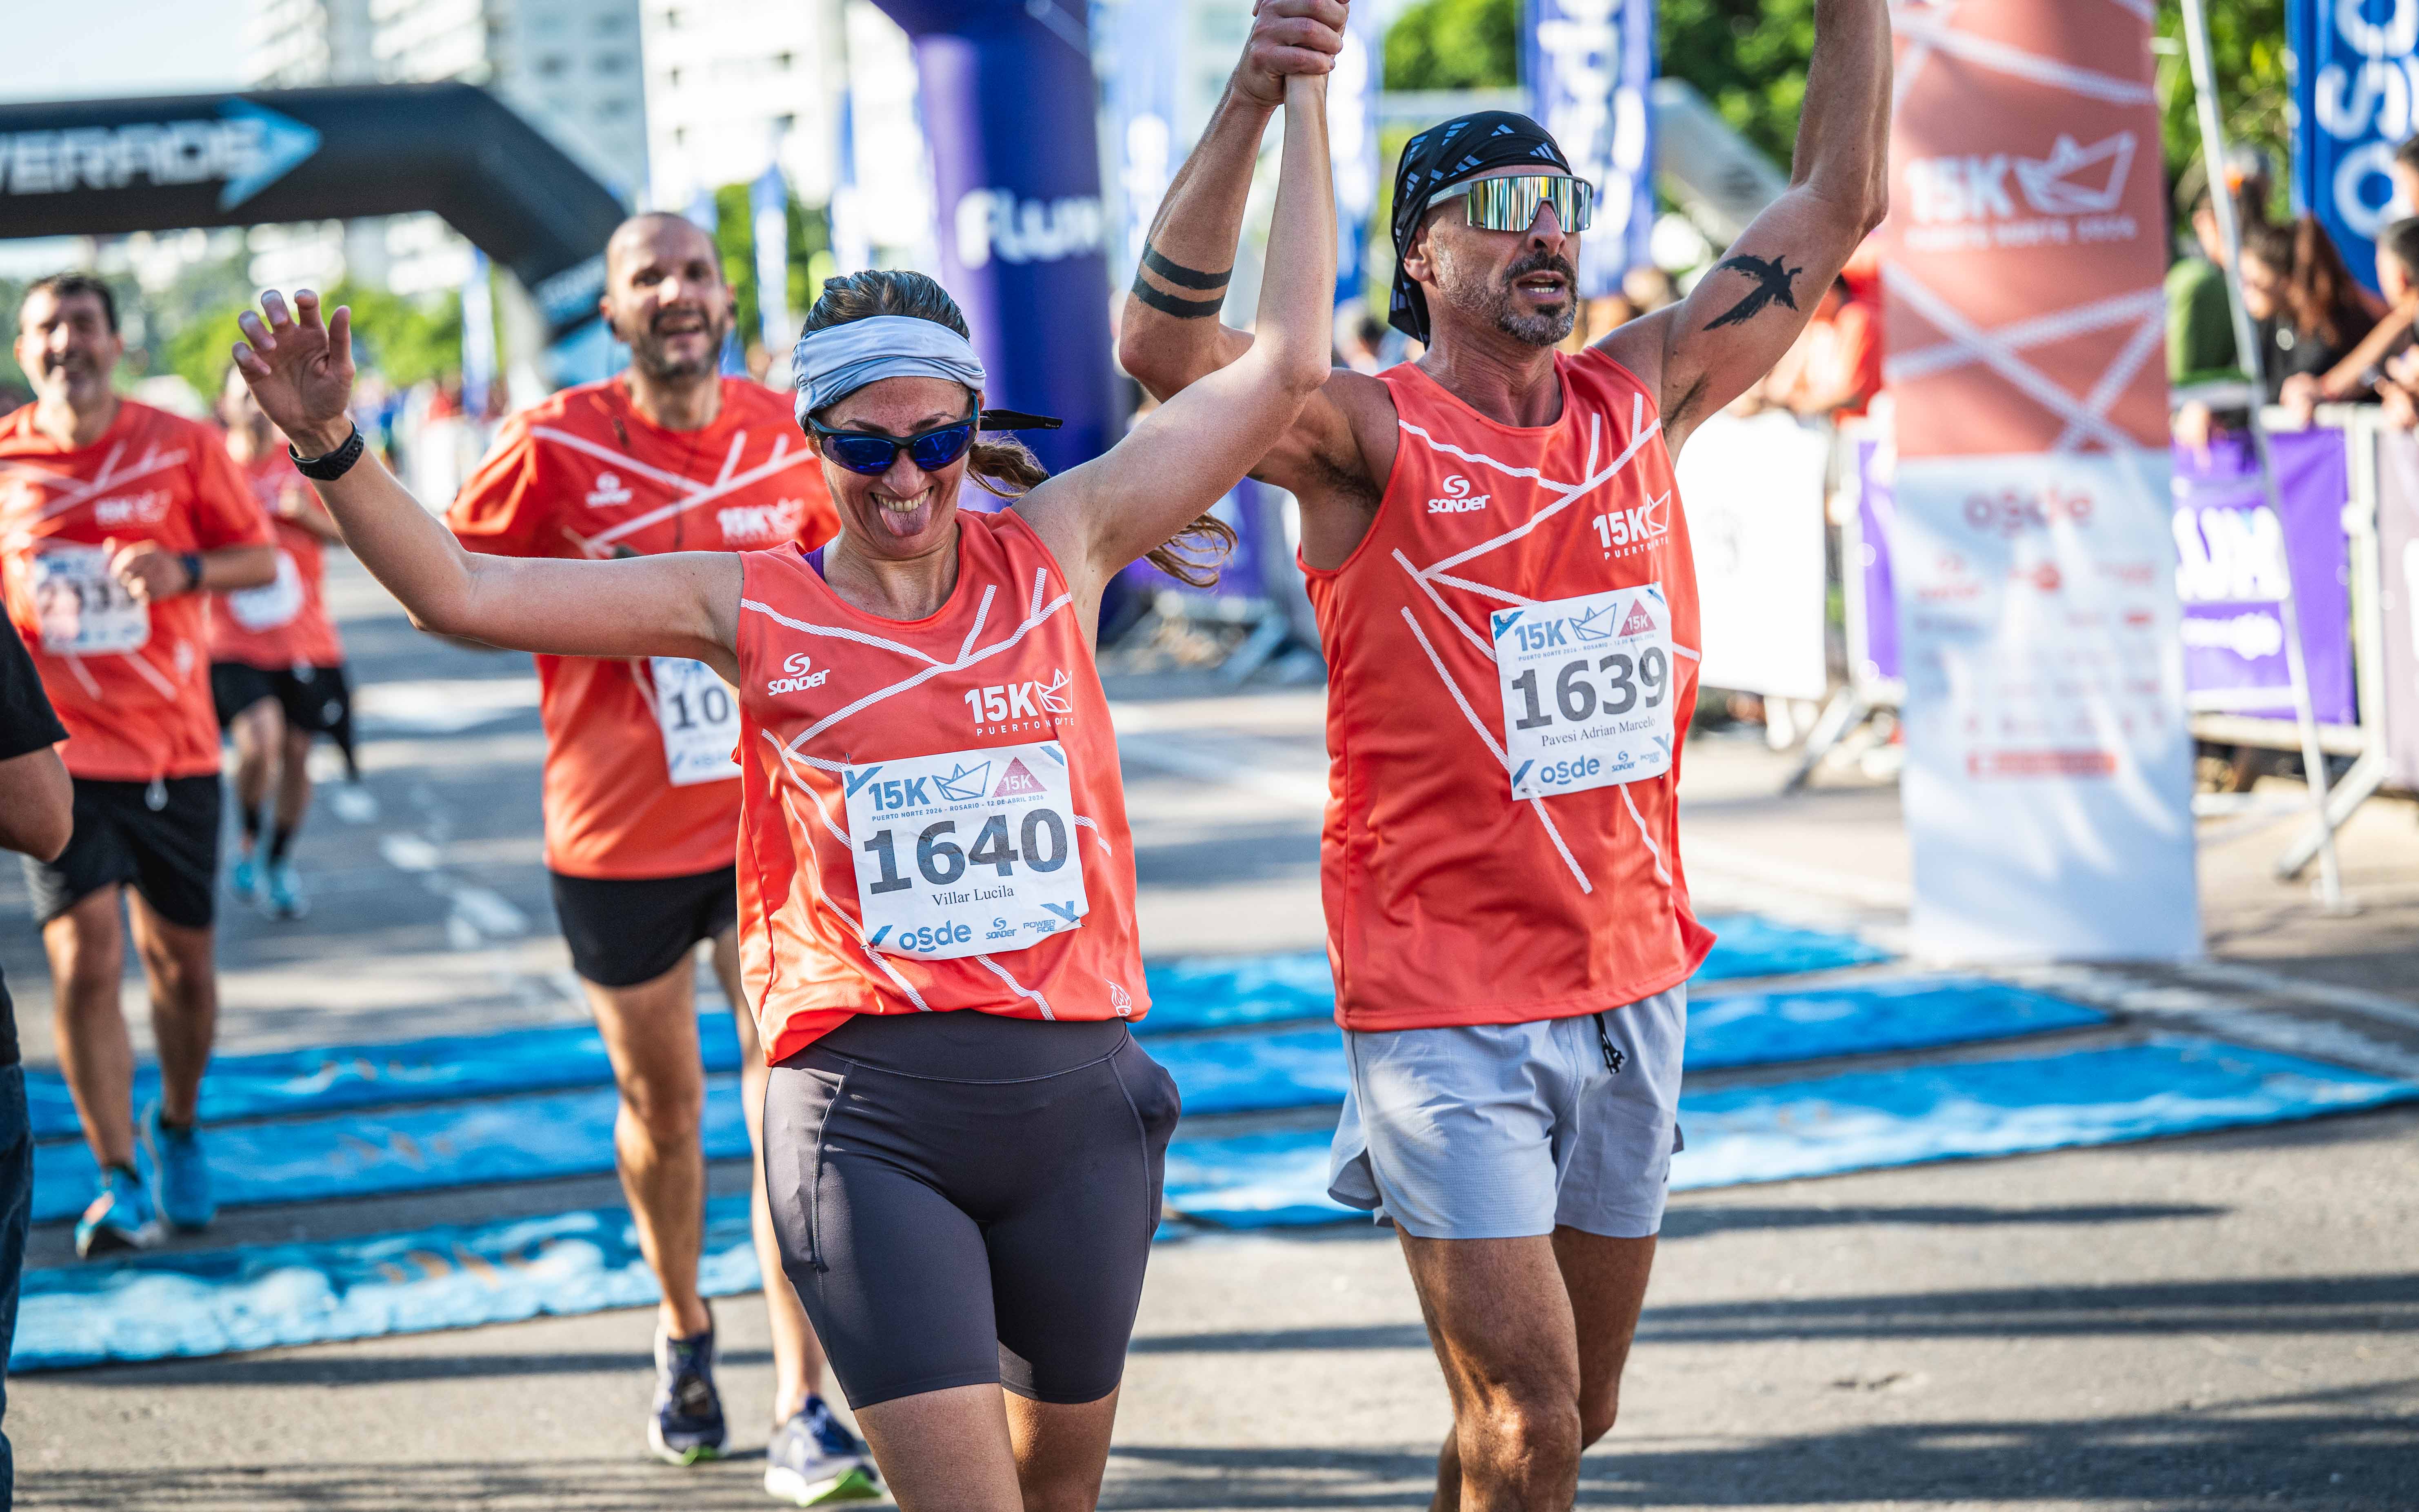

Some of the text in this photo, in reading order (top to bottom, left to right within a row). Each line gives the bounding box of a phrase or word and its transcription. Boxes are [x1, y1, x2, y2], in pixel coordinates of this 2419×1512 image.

[0, 118, 266, 194] ERADE
[1904, 153, 2013, 222] 15K
[1592, 506, 1649, 548] 15K
[1515, 619, 1567, 651] 15K
[1628, 614, 1648, 631] 15K
[964, 682, 1039, 724] 15K
[1512, 646, 1668, 730] 1639
[977, 721, 1040, 736] PUERTO
[1542, 716, 1655, 746] Pavesi Adrian Marcelo
[1004, 773, 1033, 791] 15K
[1541, 754, 1600, 785] osde
[868, 777, 931, 810] 15K
[872, 813, 899, 821] PUERTO
[950, 803, 980, 811] ROSARIO
[864, 808, 1067, 895] 1640
[932, 885, 1015, 906] Villar Lucila
[899, 920, 971, 952] osde
[1023, 919, 1056, 929] POWER
